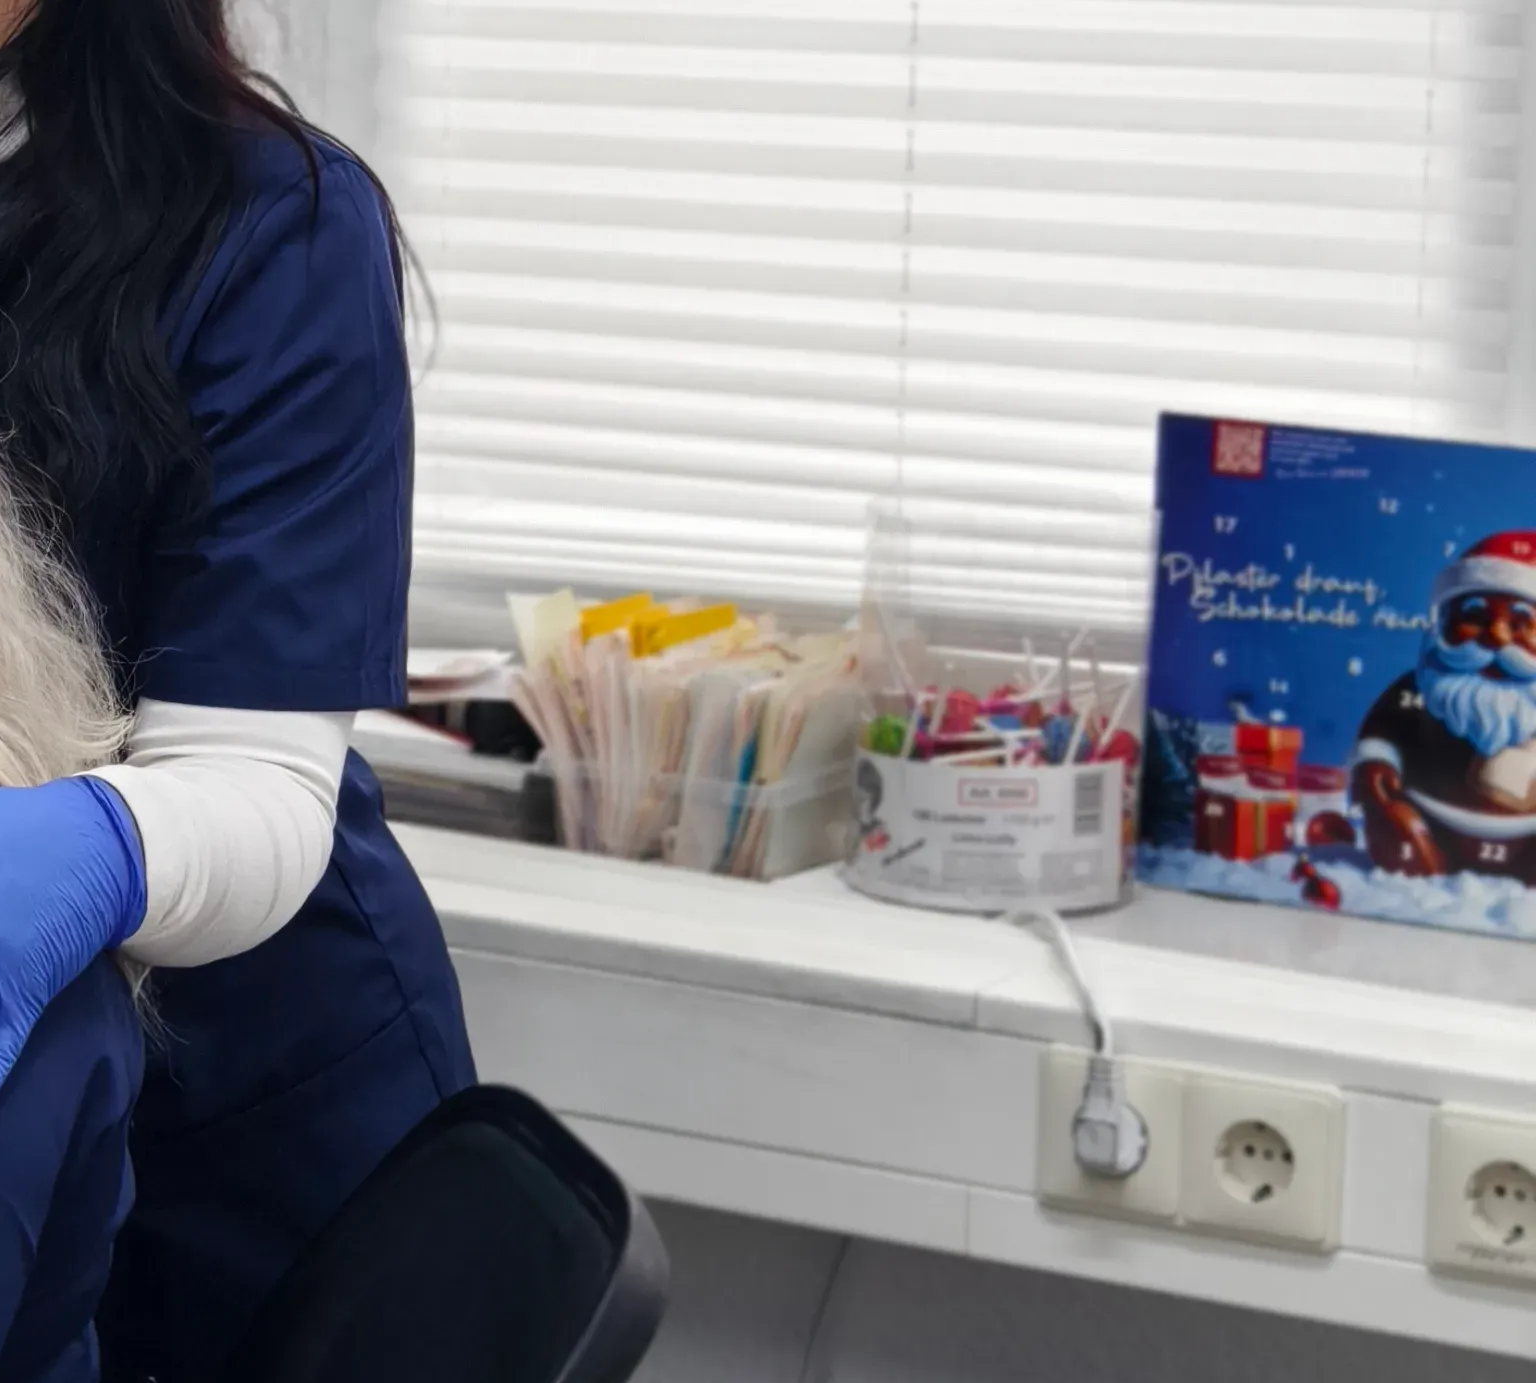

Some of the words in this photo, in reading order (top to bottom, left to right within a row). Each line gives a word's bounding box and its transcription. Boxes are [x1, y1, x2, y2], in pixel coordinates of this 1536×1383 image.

[1214, 515, 1238, 534] 17
[1161, 552, 1281, 596] Pflaster
[1190, 588, 1360, 628] Schokolade
[1399, 690, 1425, 710] 24
[1478, 842, 1508, 863] 22
